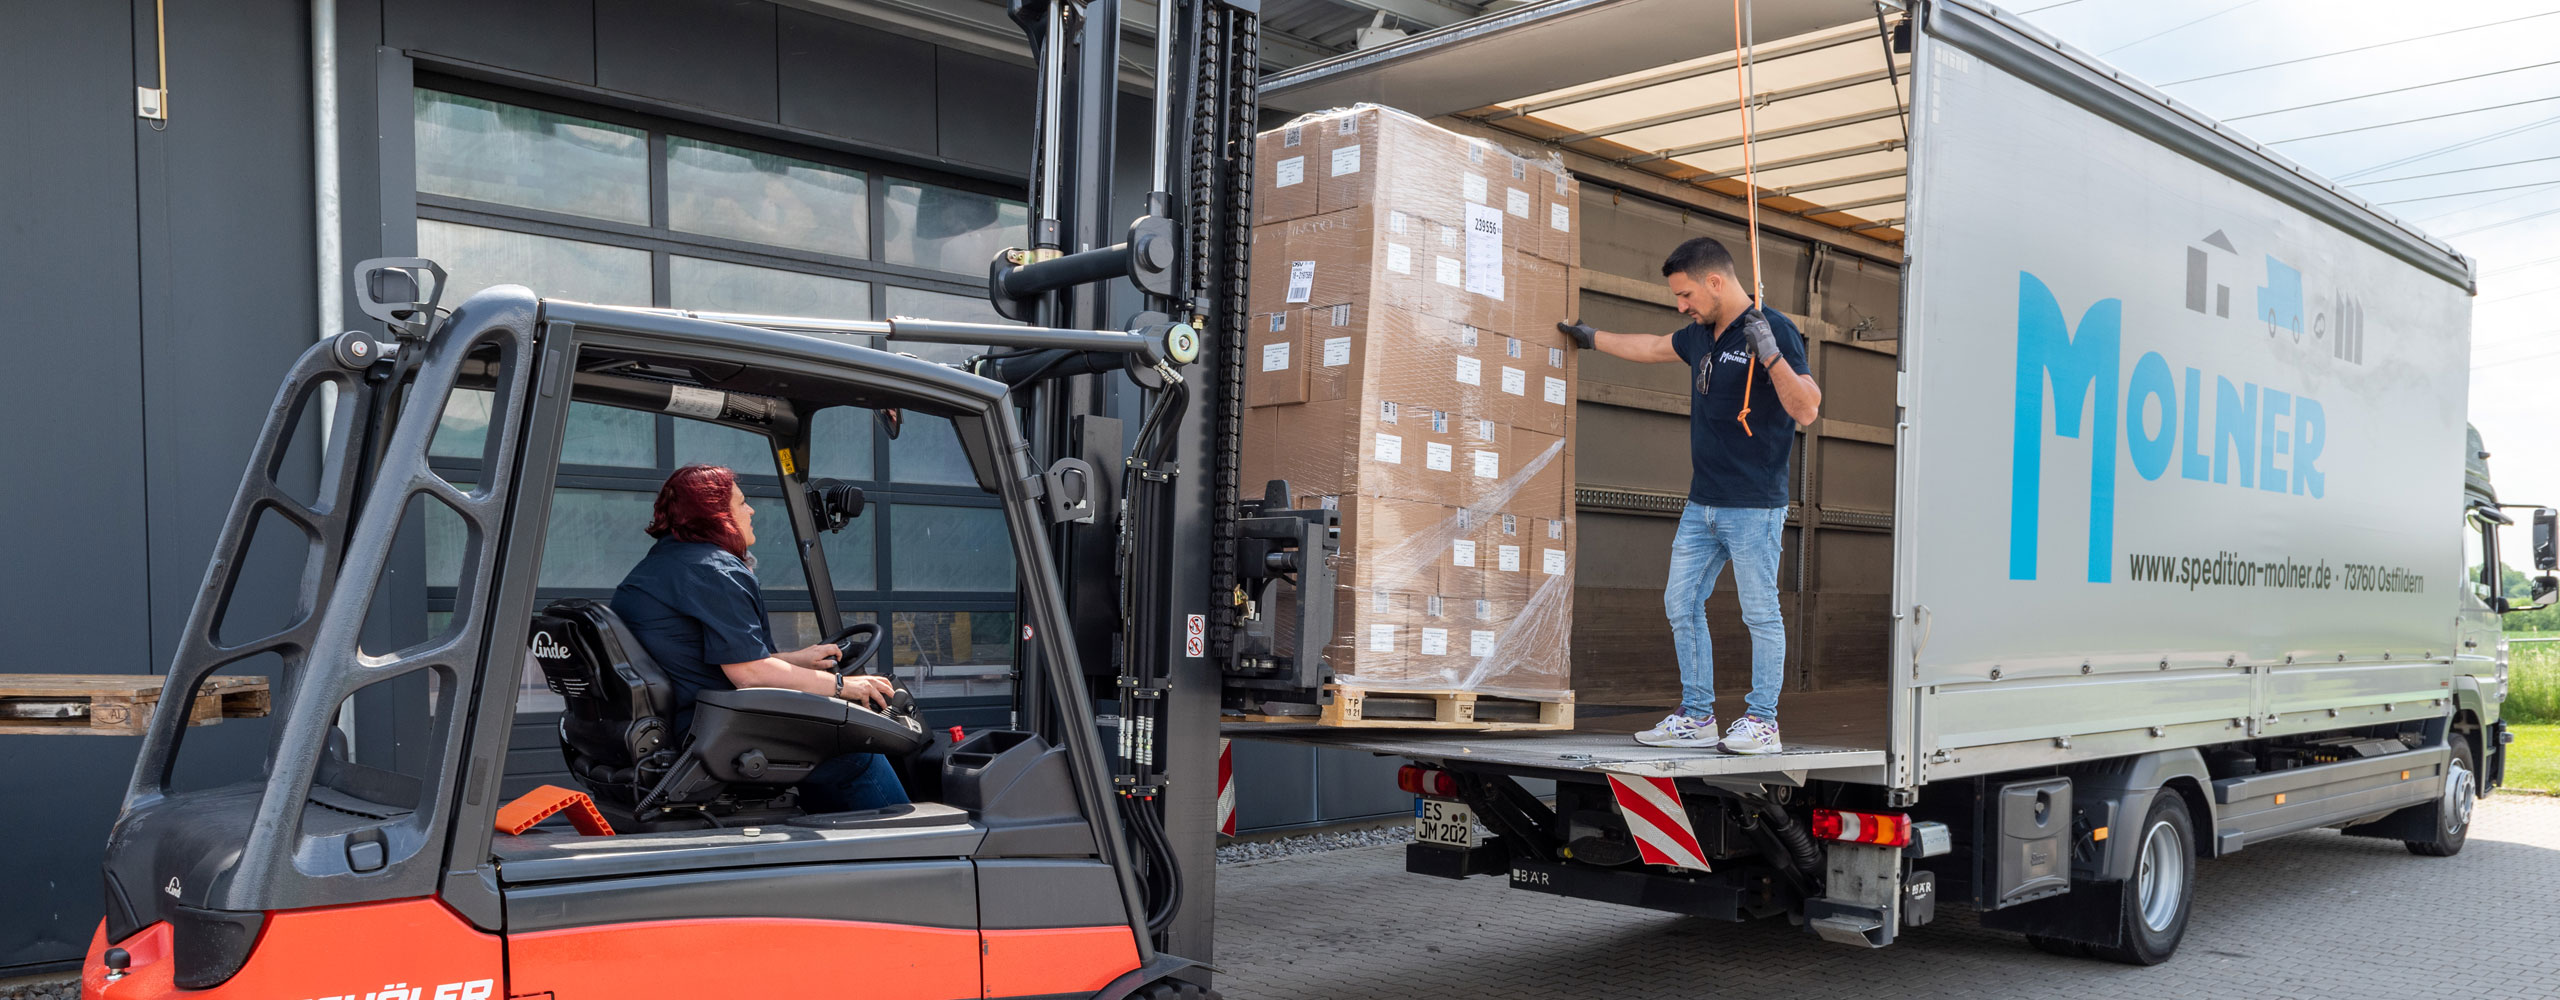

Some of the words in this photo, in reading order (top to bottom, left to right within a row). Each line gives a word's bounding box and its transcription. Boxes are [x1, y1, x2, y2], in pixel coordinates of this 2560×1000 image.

[1475, 218, 1497, 234] 239556
[2009, 270, 2326, 584] MOLNER
[2130, 551, 2331, 591] www.spedition-molner.de
[2344, 564, 2376, 591] 73760
[2377, 566, 2424, 594] Ostfildern
[532, 631, 571, 659] Linde
[1424, 802, 1442, 821] ES
[1419, 821, 1437, 840] JM
[1440, 824, 1467, 844] 202
[165, 876, 182, 898] Lind
[1521, 869, 1550, 885] BÄR
